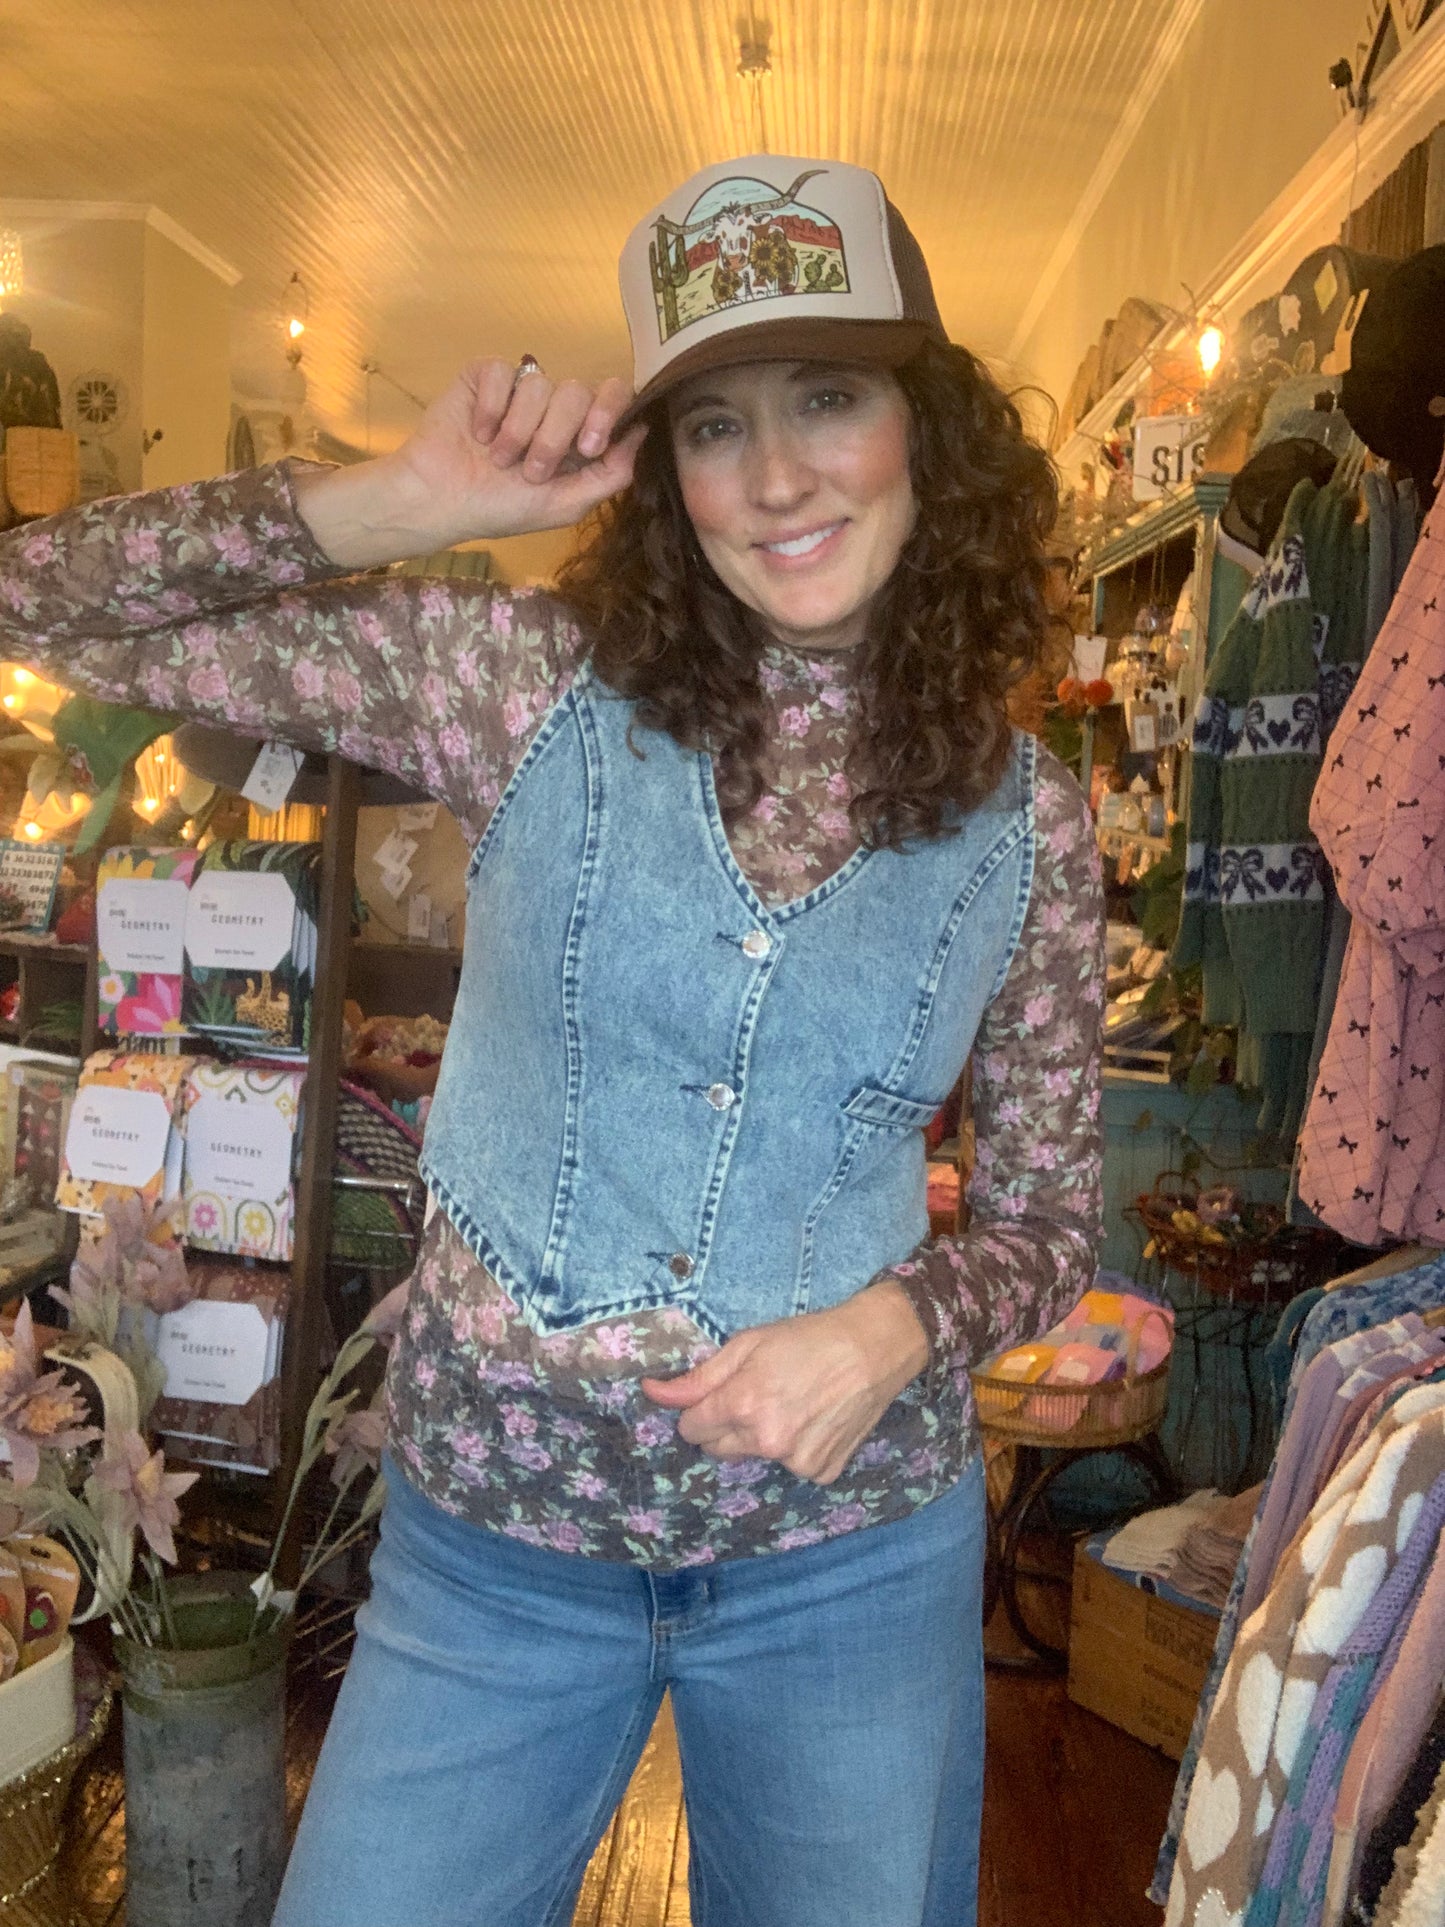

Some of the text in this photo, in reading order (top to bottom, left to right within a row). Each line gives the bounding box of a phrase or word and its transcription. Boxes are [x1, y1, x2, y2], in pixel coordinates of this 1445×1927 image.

[120, 919, 171, 932] GEOMETRY
[210, 913, 264, 927] GEOMETRY
[92, 1127, 140, 1141] GEOMETRY
[210, 1141, 262, 1158] GEOMETRY
[181, 1343, 236, 1357] GEOMETRY
